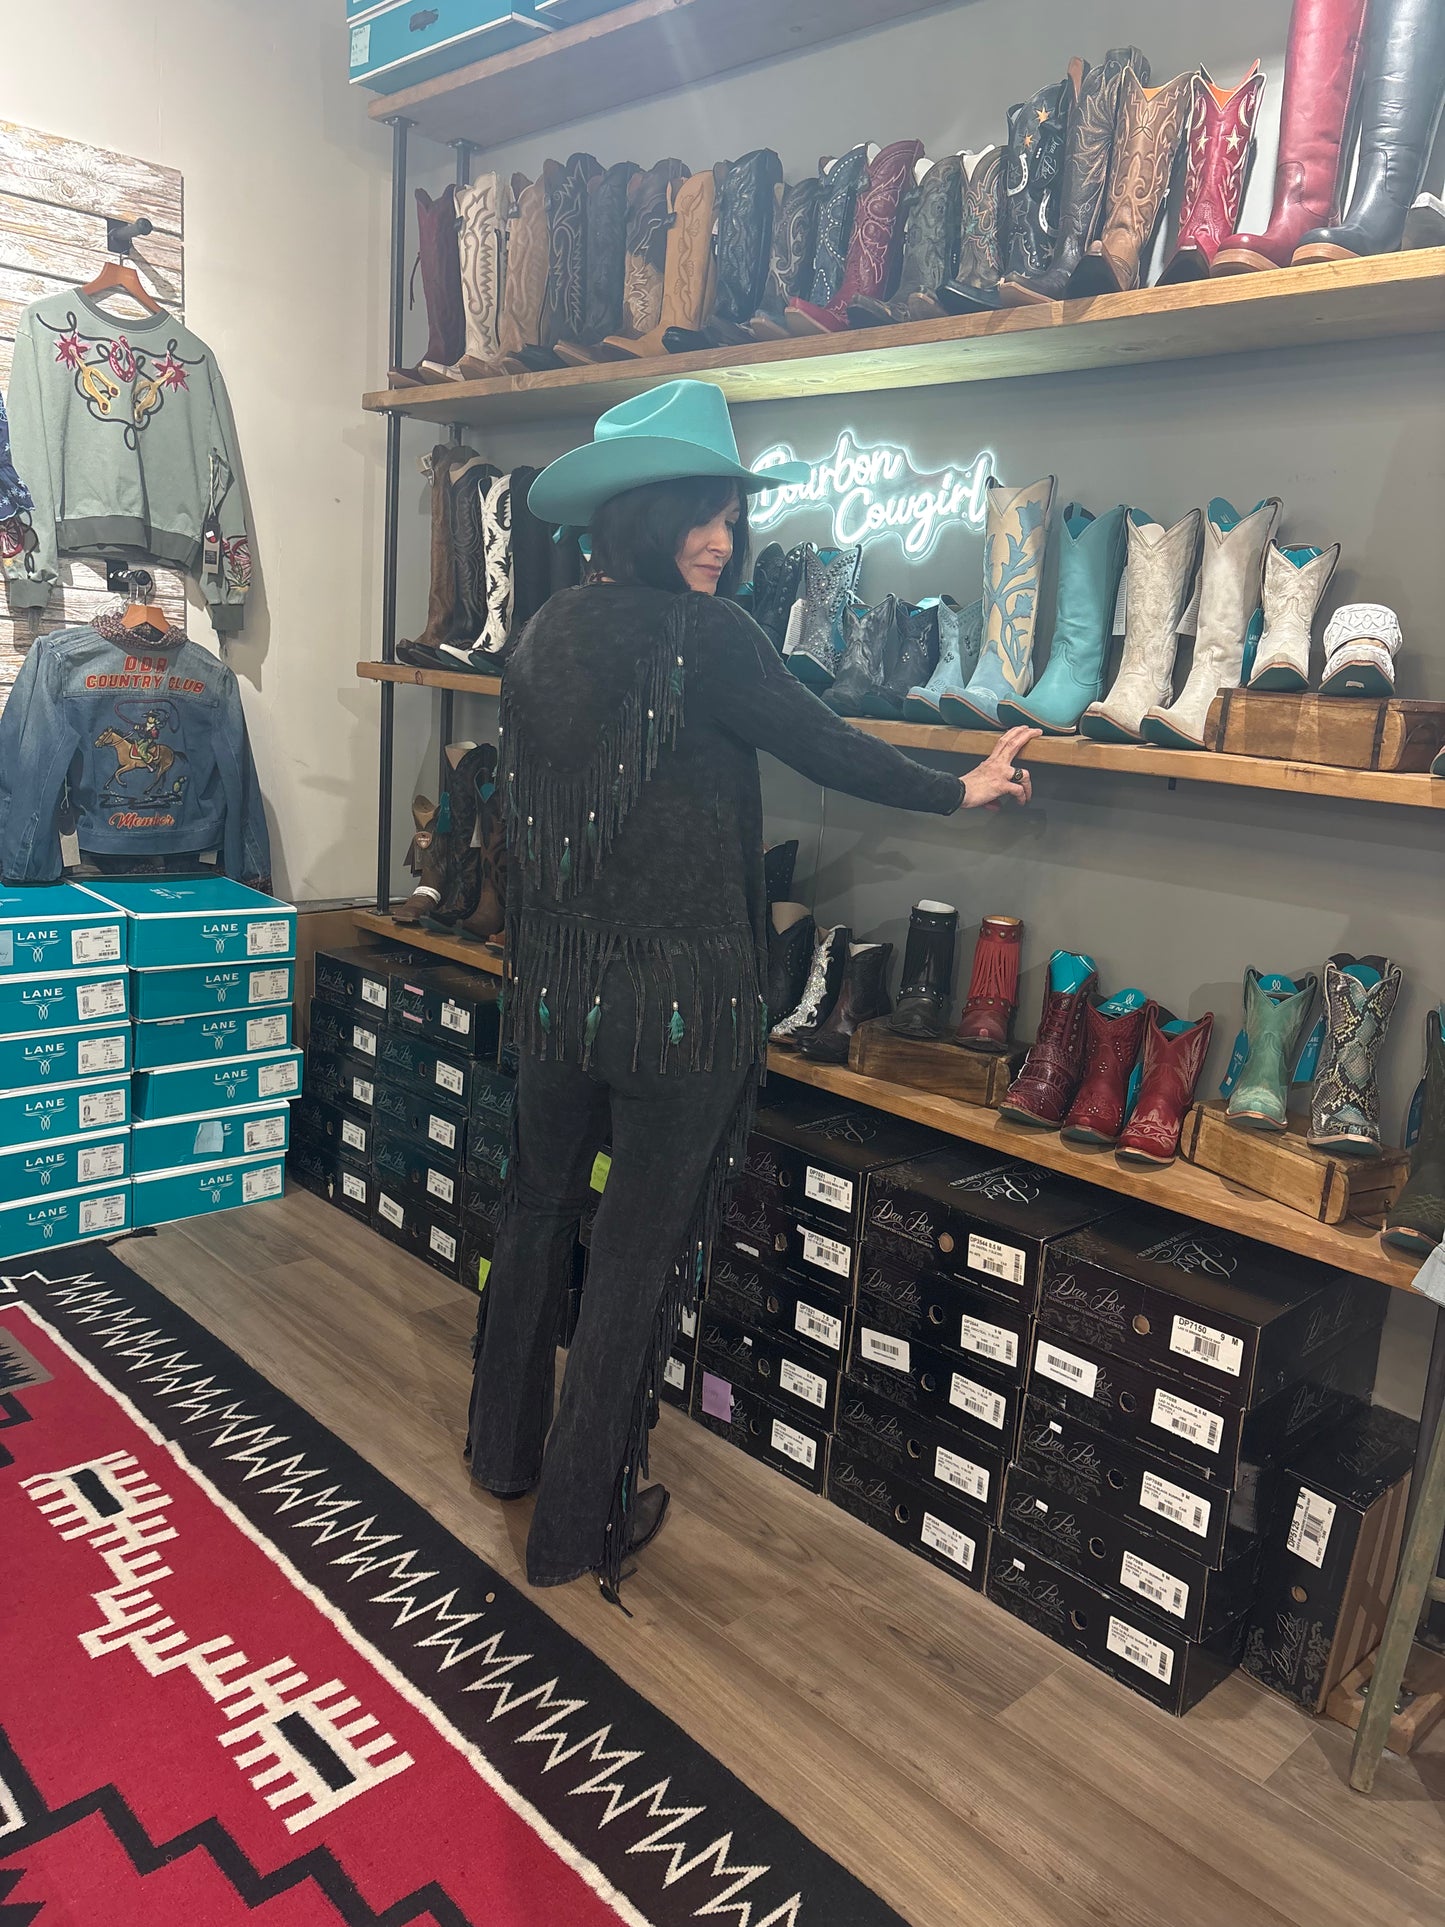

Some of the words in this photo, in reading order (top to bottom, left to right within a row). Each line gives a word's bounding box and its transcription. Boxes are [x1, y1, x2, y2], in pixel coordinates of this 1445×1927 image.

[835, 456, 990, 552] Cowgirl
[85, 674, 165, 689] COUNTRY
[167, 676, 206, 694] CLUB
[108, 812, 175, 828] Member
[17, 930, 59, 941] LANE
[203, 923, 238, 933] LANE
[205, 973, 239, 984] LANE
[22, 987, 63, 999] LANE
[202, 1020, 237, 1031] LANE
[25, 1042, 65, 1055] LANE
[214, 1069, 248, 1081] LANE
[25, 1098, 65, 1112] LANE
[25, 1153, 65, 1167] LANE
[200, 1173, 233, 1186] LANE
[980, 1174, 1040, 1204] Post
[28, 1206, 68, 1221] LANE
[871, 1199, 904, 1222] Dan
[904, 1210, 934, 1235] Post
[1173, 1240, 1238, 1279] Post
[862, 1267, 892, 1290] Dan
[1050, 1272, 1088, 1299] Dan
[1089, 1287, 1126, 1314] Post
[1177, 1317, 1207, 1335] DP7150
[1219, 1332, 1225, 1342] 9
[1230, 1336, 1239, 1347] M
[1029, 1424, 1065, 1450] Dan
[1066, 1441, 1101, 1468] Post
[1010, 1492, 1047, 1520] Dan
[1048, 1511, 1081, 1538] Post
[1287, 1520, 1301, 1548] DP5125
[995, 1559, 1030, 1587] Dan
[1032, 1580, 1065, 1608] Post
